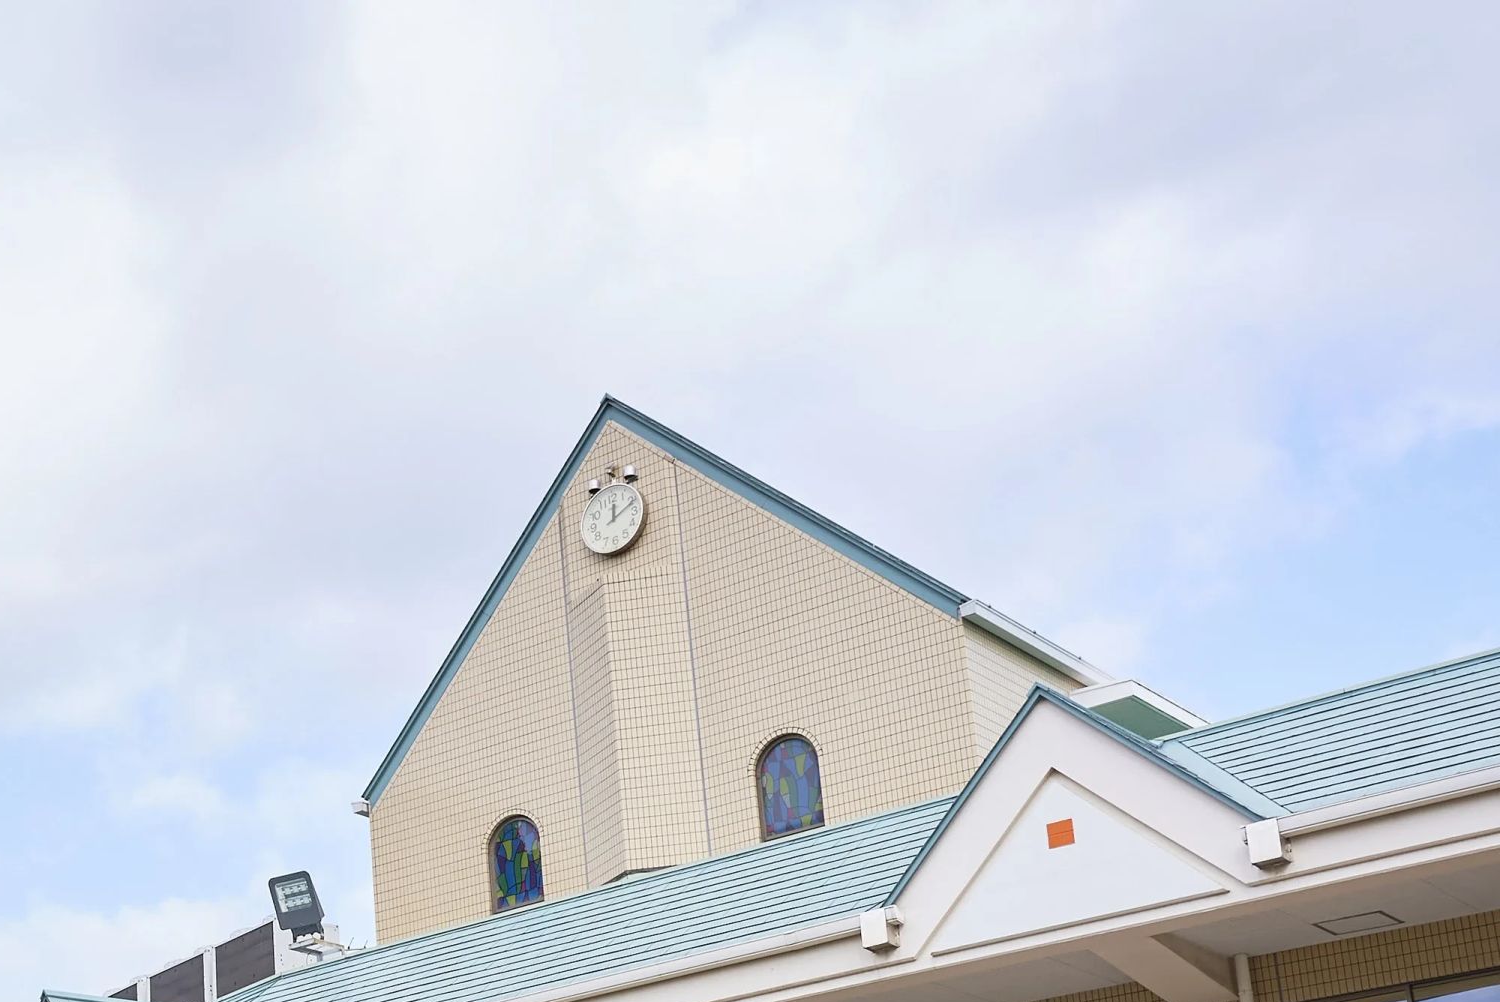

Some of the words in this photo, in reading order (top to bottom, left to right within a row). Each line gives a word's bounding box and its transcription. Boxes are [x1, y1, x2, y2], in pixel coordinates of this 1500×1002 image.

[608, 493, 618, 504] 12
[598, 499, 607, 510] 11
[589, 510, 601, 521] 10
[631, 506, 638, 516] 3
[629, 518, 635, 526] 4
[590, 522, 597, 533] 9
[594, 531, 601, 541] 8
[622, 529, 629, 539] 5
[603, 537, 609, 546] 7
[612, 536, 619, 545] 6
